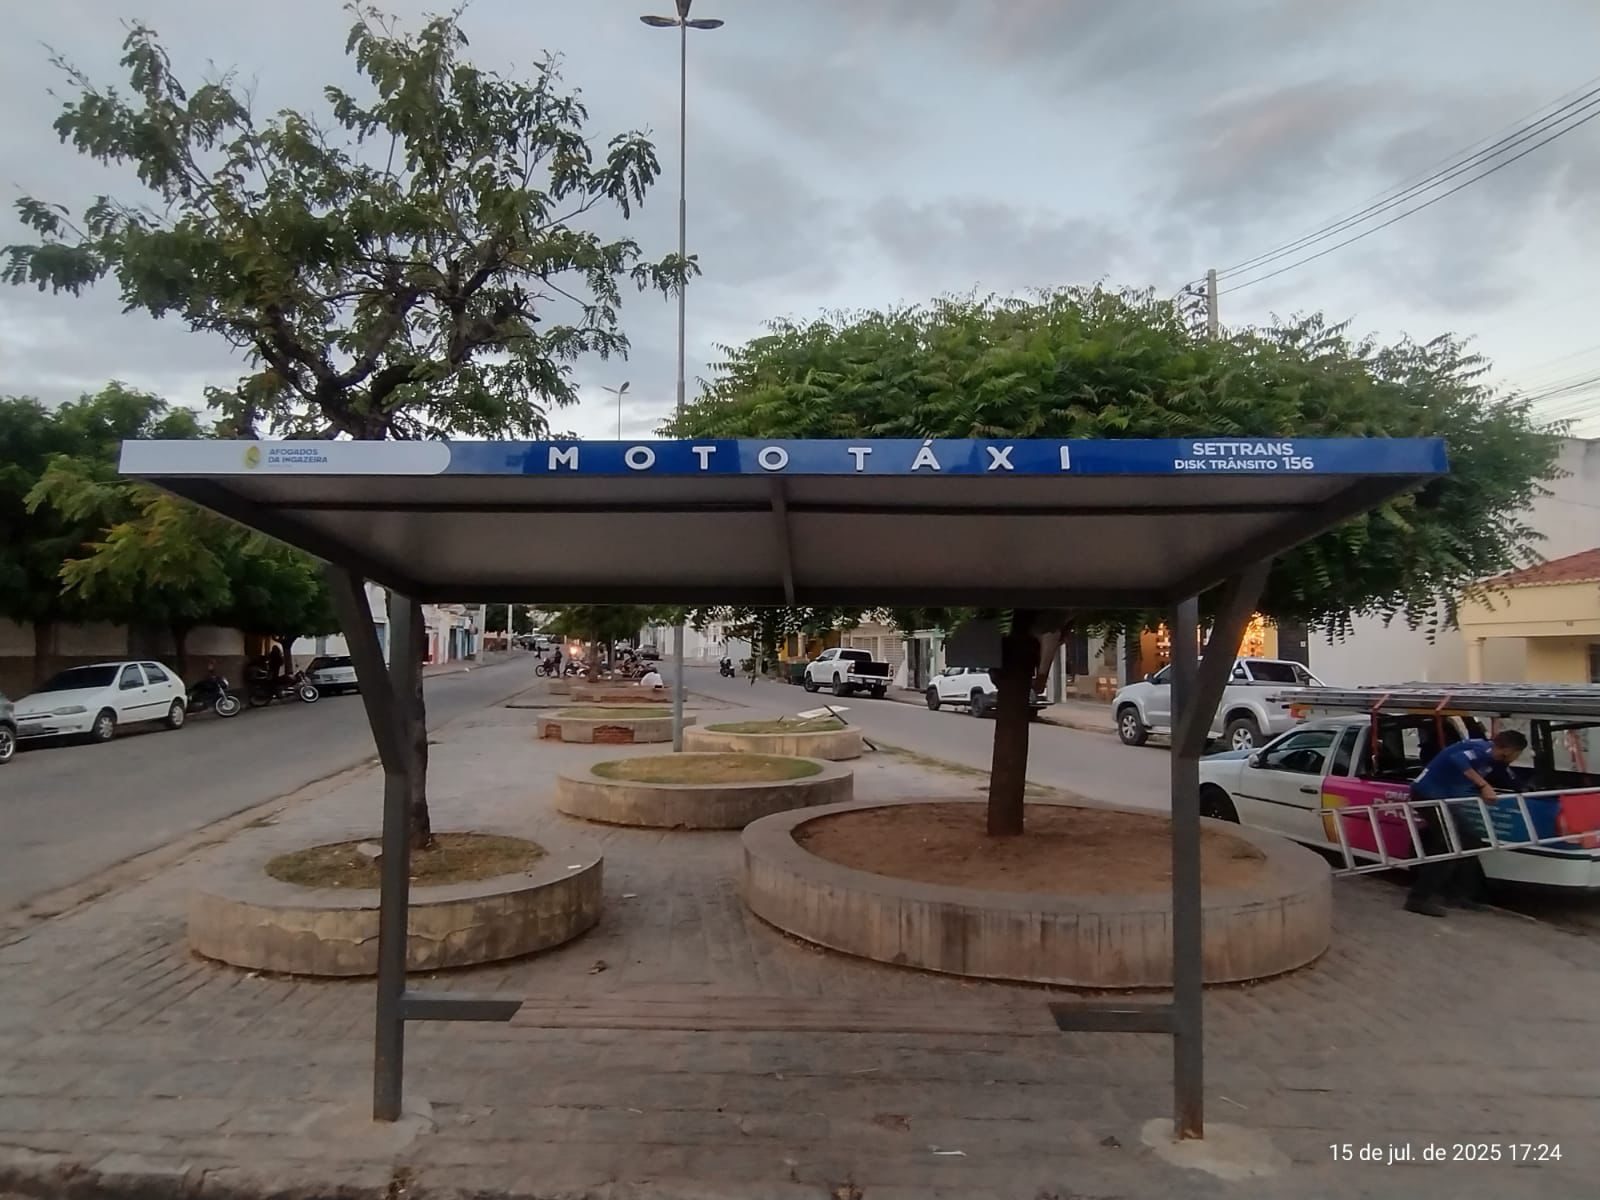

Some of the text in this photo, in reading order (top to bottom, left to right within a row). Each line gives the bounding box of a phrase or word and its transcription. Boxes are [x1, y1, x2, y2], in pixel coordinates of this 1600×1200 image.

[269, 448, 319, 456] AFOGADOS
[548, 439, 1070, 471] MOTO TÁXI
[1192, 442, 1294, 456] SETTRANS
[268, 456, 328, 464] DA INGAZEIRA
[1174, 456, 1314, 470] DISK TRÂNSITO 156
